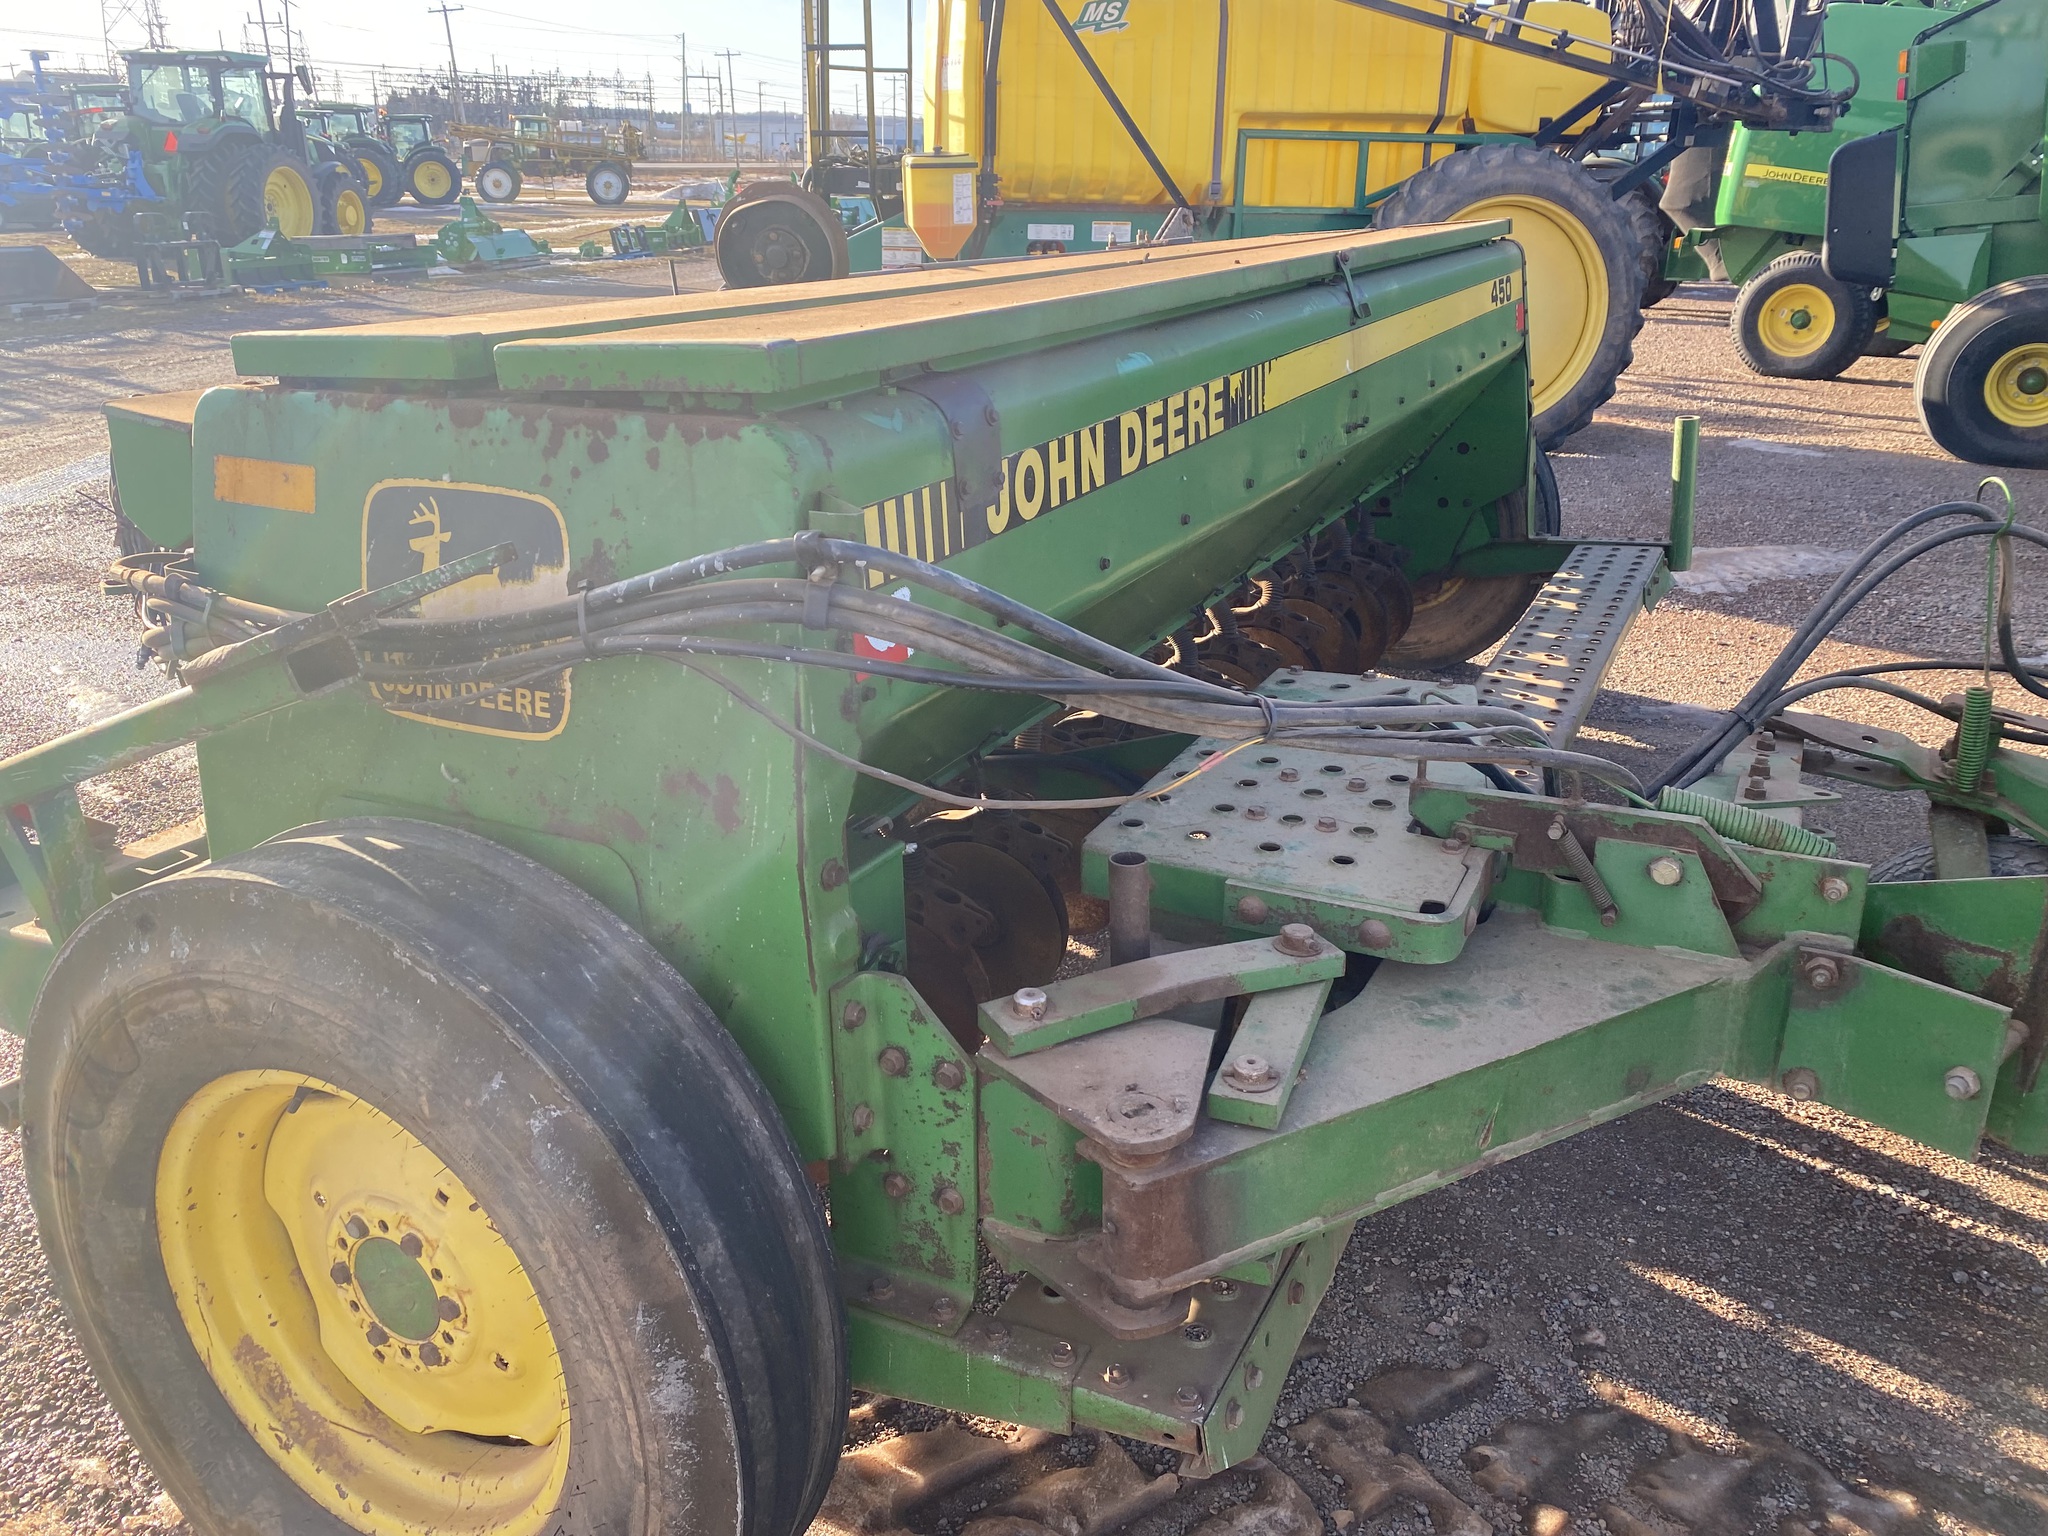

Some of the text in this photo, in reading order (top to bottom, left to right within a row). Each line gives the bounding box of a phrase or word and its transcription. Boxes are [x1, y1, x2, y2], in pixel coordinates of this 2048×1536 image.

[1082, 2, 1122, 22] MS
[1762, 168, 1791, 180] JOHN
[1491, 275, 1511, 307] 450
[986, 376, 1225, 535] JOHN DEERE
[460, 681, 551, 719] DEERE
